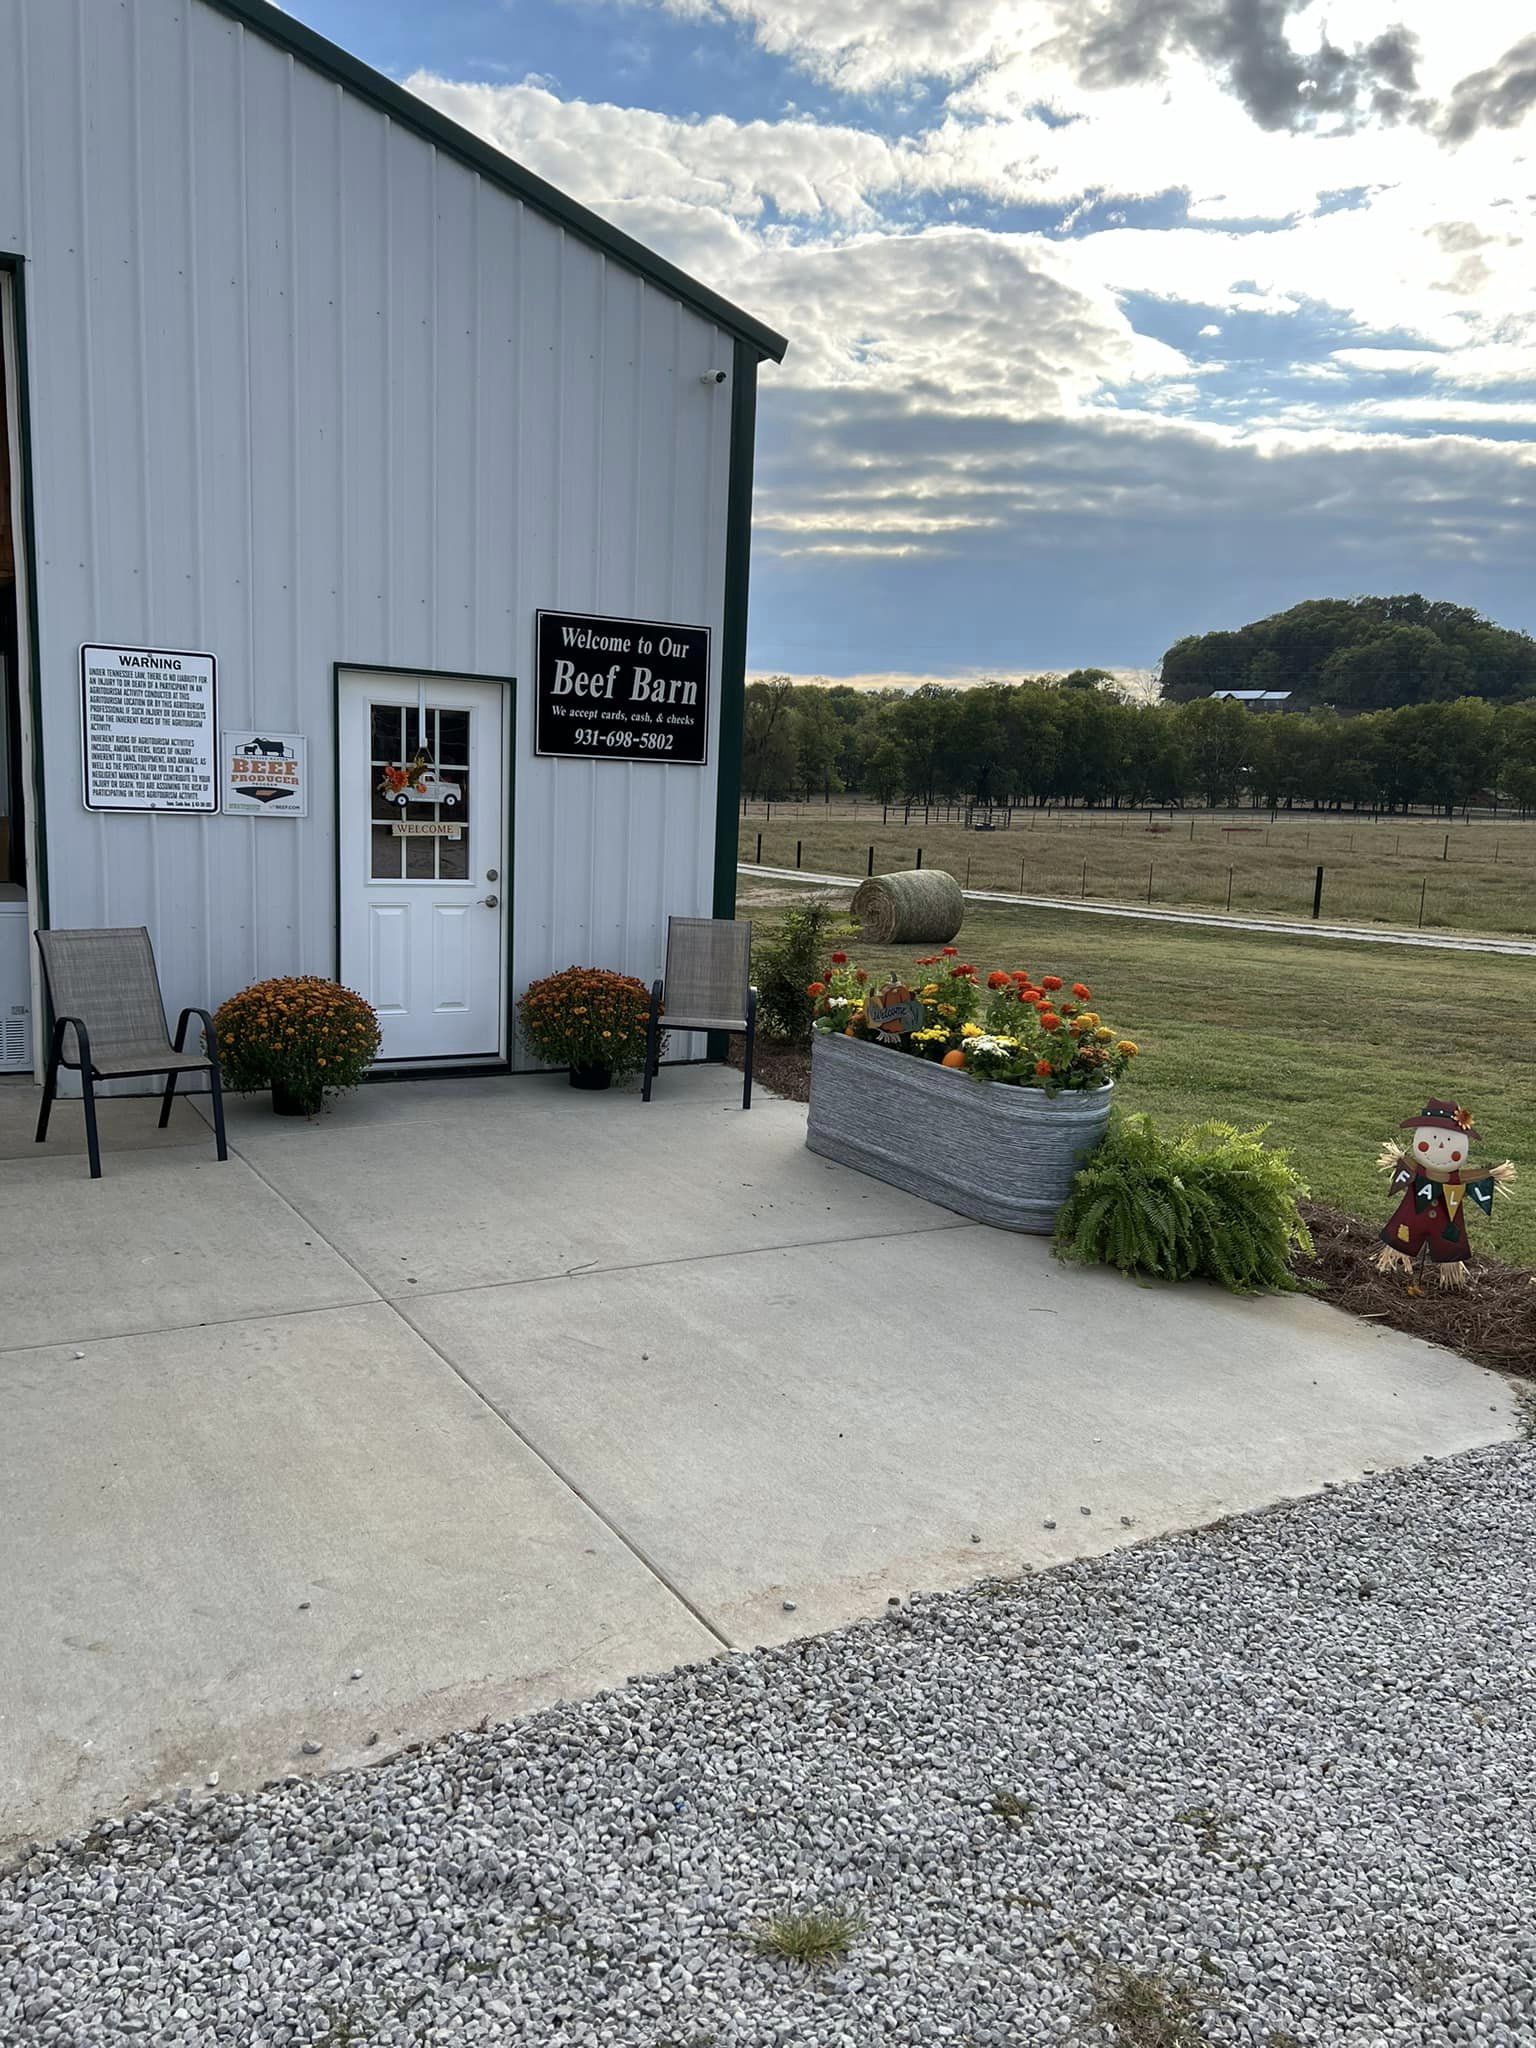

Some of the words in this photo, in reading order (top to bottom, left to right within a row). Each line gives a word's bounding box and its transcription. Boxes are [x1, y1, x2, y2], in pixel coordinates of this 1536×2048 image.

[562, 627, 631, 652] Welcome
[638, 637, 652, 654] to
[659, 637, 689, 658] Our
[119, 656, 182, 670] WARNING
[550, 659, 621, 699] Beef
[629, 666, 698, 705] Barn
[552, 706, 566, 716] We
[569, 708, 598, 719] accept
[601, 711, 627, 721] cards,
[631, 713, 652, 723] cash,
[656, 714, 663, 723] &
[667, 714, 694, 725] checks
[574, 728, 673, 750] 931-698-5802
[232, 758, 298, 775] BEEF
[232, 775, 299, 784] PRODUCER
[398, 825, 454, 833] WELCOME
[1395, 1170, 1491, 1206] FALL
